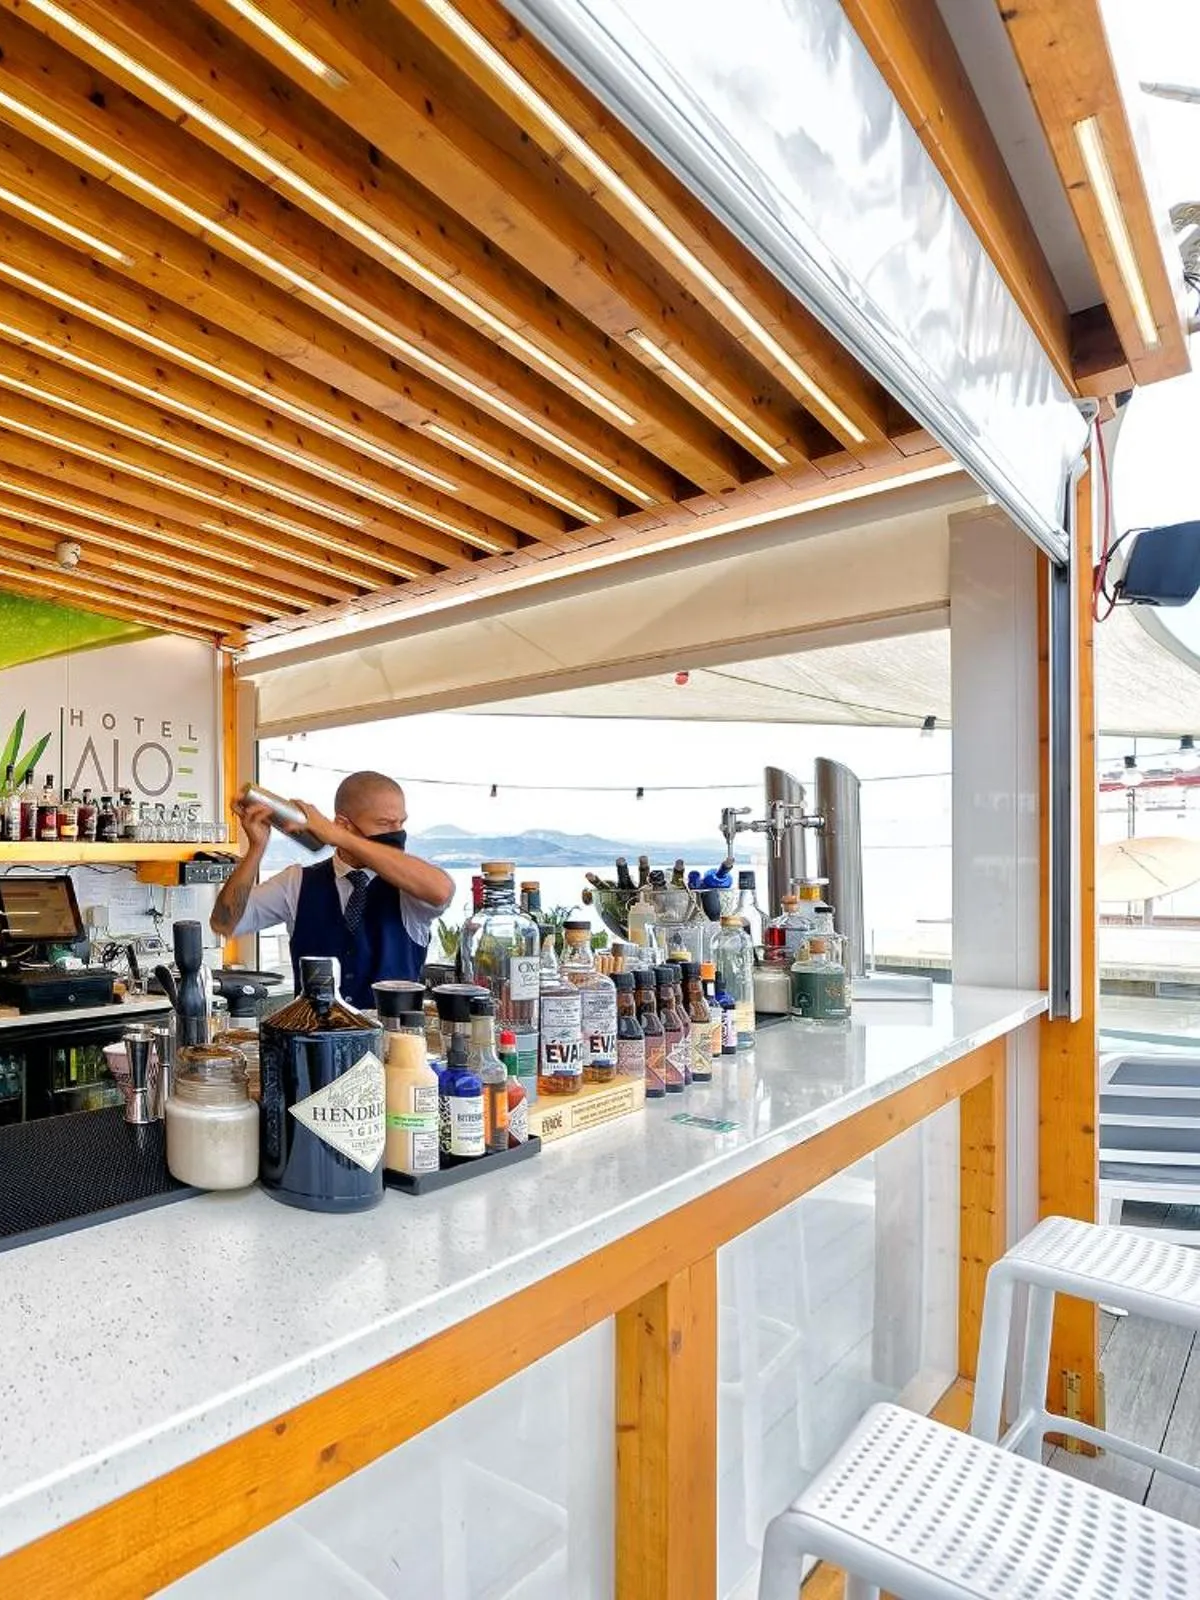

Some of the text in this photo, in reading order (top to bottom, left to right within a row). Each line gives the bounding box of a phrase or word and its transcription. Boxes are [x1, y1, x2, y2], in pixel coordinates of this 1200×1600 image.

[70, 708, 198, 742] HOTEL
[70, 735, 199, 797] ALOE
[312, 1100, 384, 1121] HENDRI
